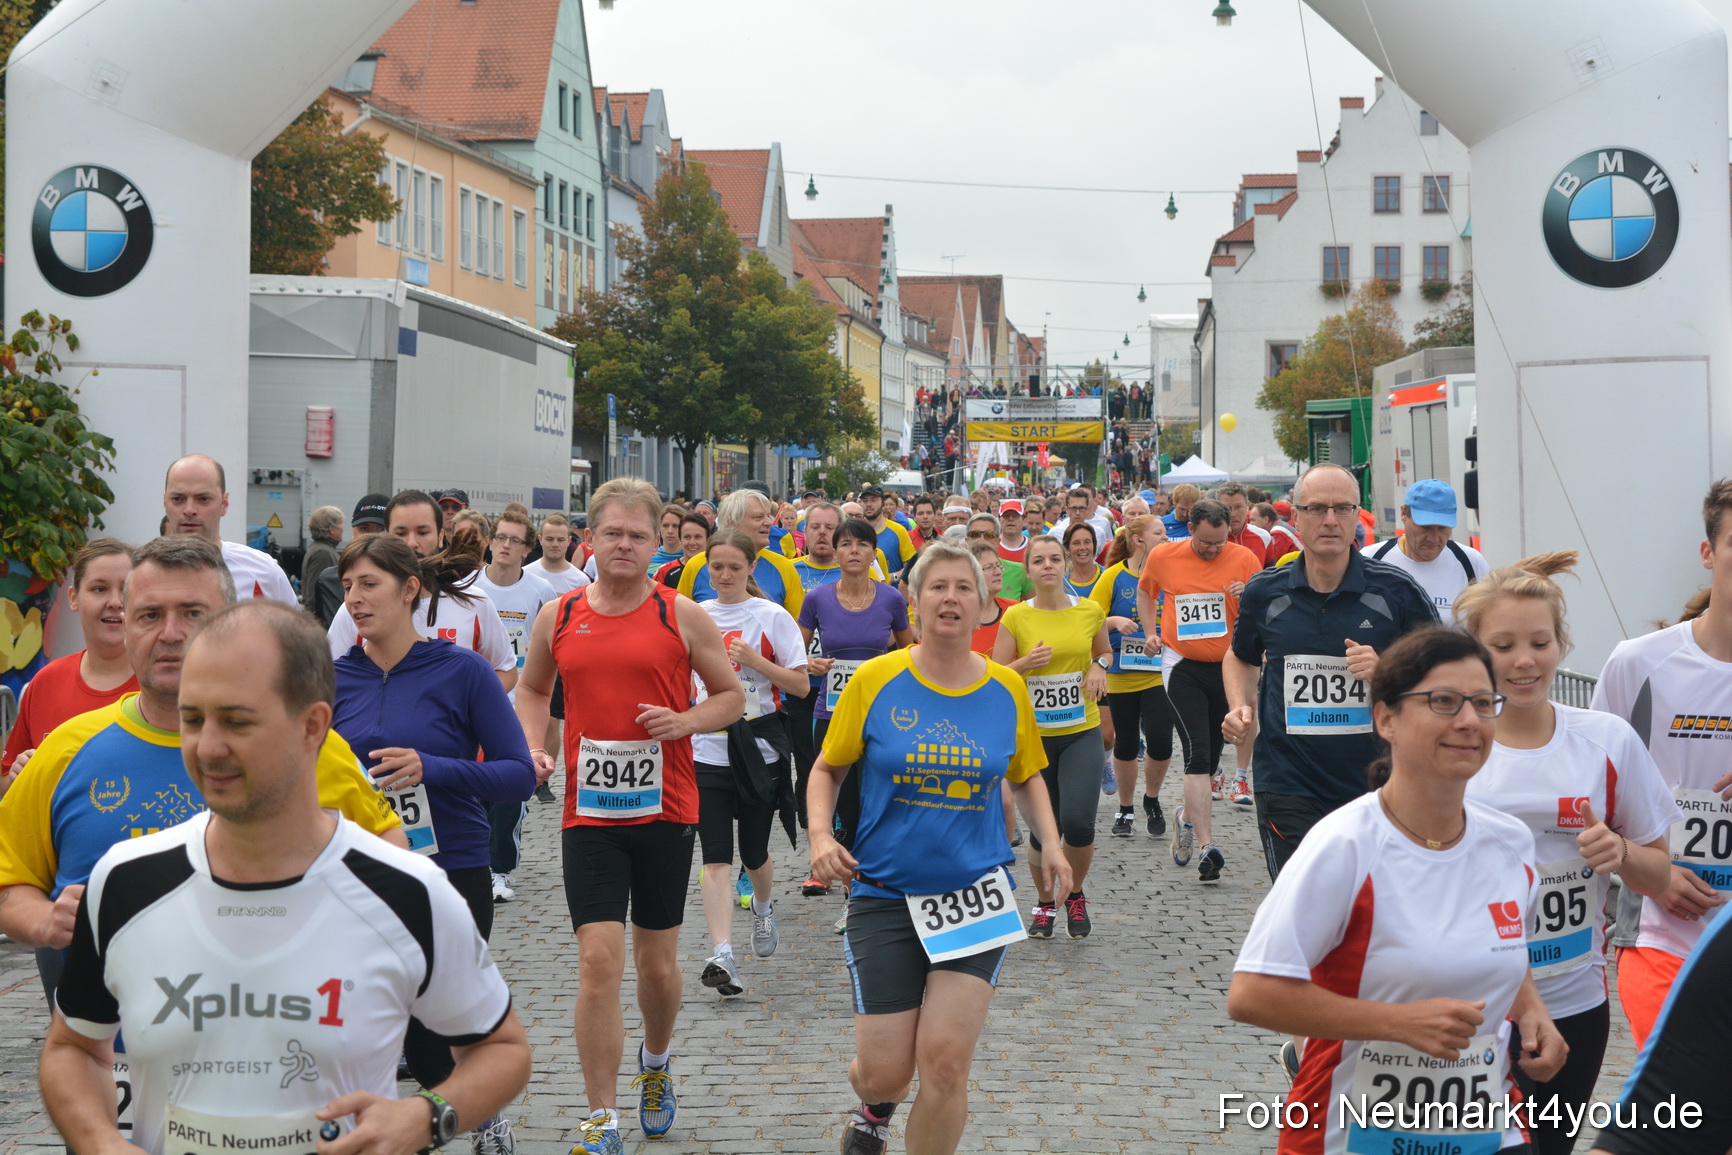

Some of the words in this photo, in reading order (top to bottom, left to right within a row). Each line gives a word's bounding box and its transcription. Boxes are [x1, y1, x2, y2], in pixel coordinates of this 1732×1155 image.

[1553, 151, 1669, 199] BMW
[40, 168, 144, 212] BMW
[535, 389, 567, 436] BOCK
[1011, 425, 1058, 437] START
[1181, 604, 1221, 622] 3415
[1286, 662, 1314, 671] PARTL
[1316, 663, 1349, 671] Neumar
[1048, 678, 1075, 686] Neumarkt
[1293, 674, 1366, 704] 2034
[1034, 685, 1080, 708] 2589
[1044, 712, 1073, 720] Yvonne
[1308, 711, 1350, 724] Johann
[1670, 714, 1732, 731] grase
[581, 744, 605, 755] PARTL
[606, 747, 647, 756] Neumarkt
[585, 758, 655, 788] 2942
[961, 770, 981, 778] 2014
[105, 780, 116, 788] 15
[97, 791, 121, 799] Jahre
[597, 794, 642, 808] Wilfried
[1675, 799, 1717, 813] PARTL
[1684, 817, 1732, 860] 20
[1539, 871, 1578, 886] umarkt
[1701, 869, 1732, 887] Mar
[217, 906, 287, 917] STANNO
[921, 878, 1005, 931] 3395
[1535, 885, 1587, 935] 95
[1497, 924, 1523, 937] DKMS
[1361, 1048, 1414, 1067] PARTL
[1418, 1054, 1480, 1069] Neumarkt
[172, 1061, 273, 1076] SPORTGEIST
[168, 1120, 217, 1148] PARTL
[222, 1128, 312, 1150] Neumarkt
